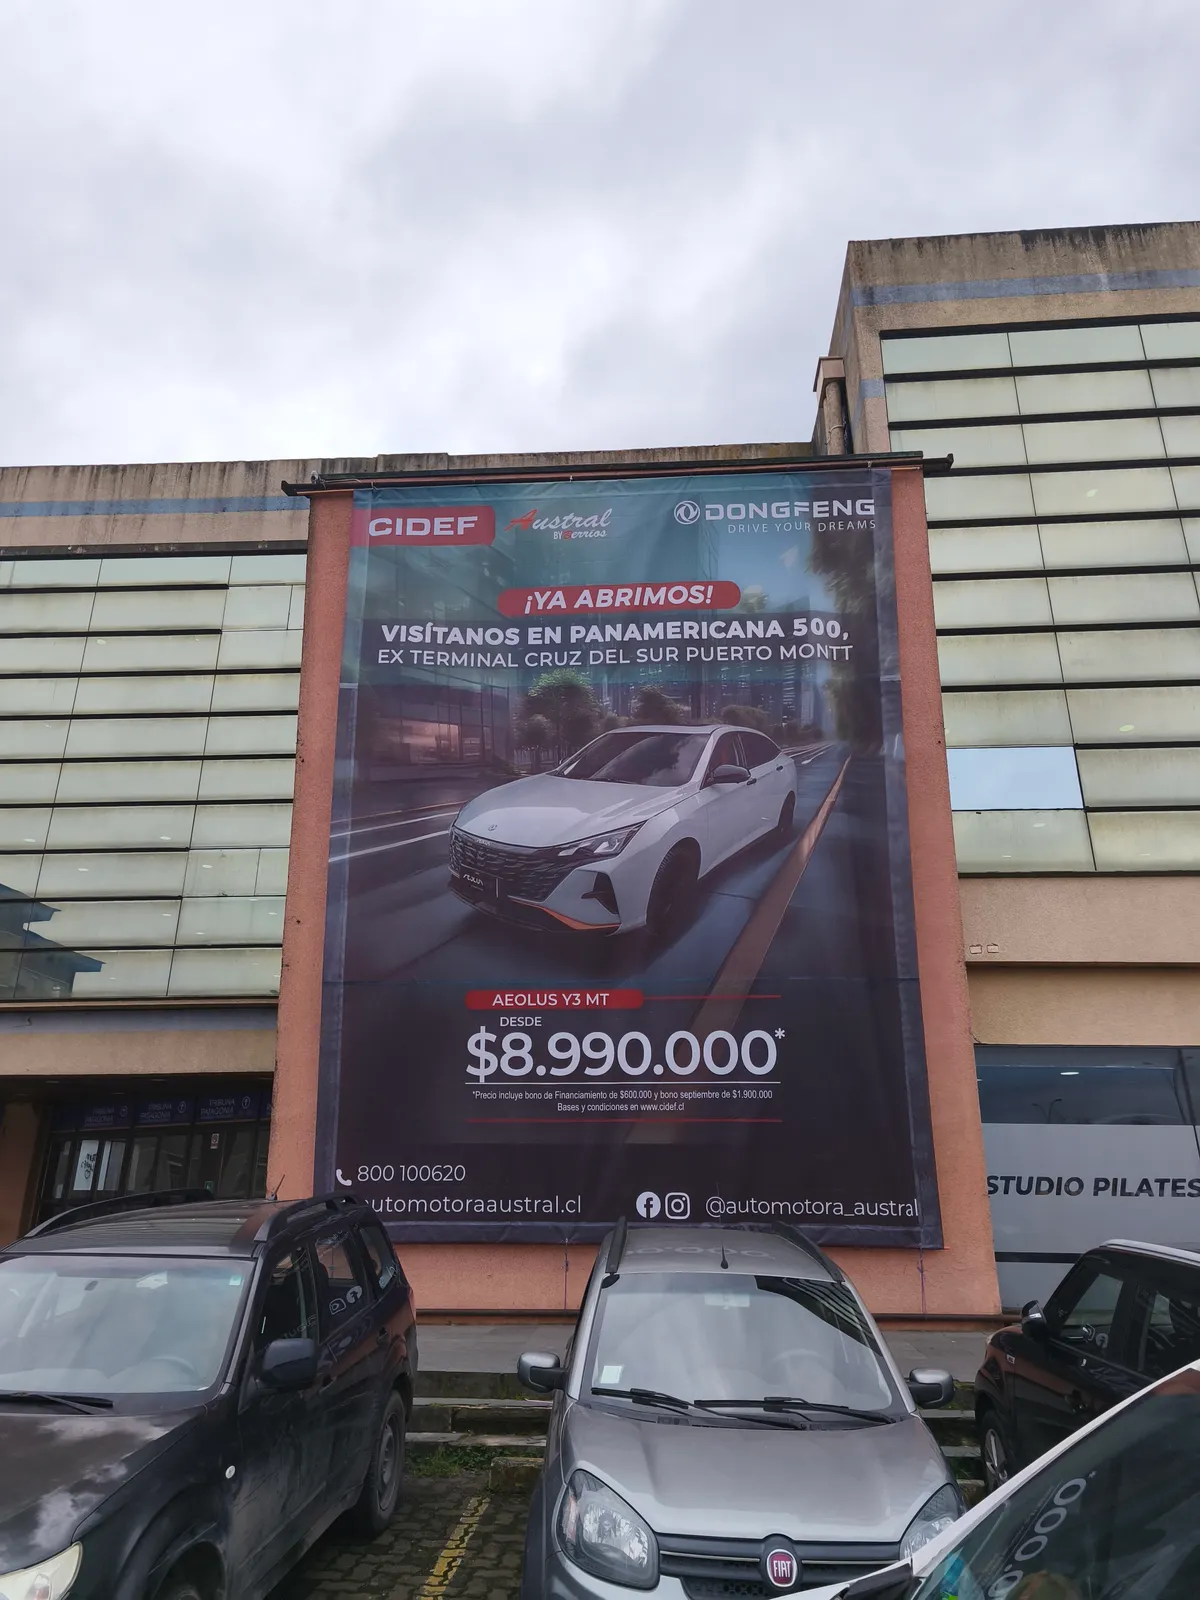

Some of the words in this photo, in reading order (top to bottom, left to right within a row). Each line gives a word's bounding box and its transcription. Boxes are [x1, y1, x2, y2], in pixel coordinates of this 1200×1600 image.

[705, 498, 875, 521] DONGFENG
[368, 515, 479, 537] CIDEF
[504, 508, 613, 532] Austral
[727, 523, 768, 534] DRIVE
[774, 521, 811, 533] YOUR
[817, 519, 876, 533] DREAMS
[553, 531, 563, 540] BY
[524, 589, 567, 615] ¡YA
[573, 584, 714, 609] ABRIMOS!
[381, 622, 520, 646] VISÍTANOS
[527, 626, 562, 645] EN
[570, 619, 785, 644] PANAMERICANA
[792, 617, 850, 641] 500,
[377, 649, 404, 665] EX
[409, 649, 519, 668] TERMINAL
[524, 651, 582, 667] CRUZ
[589, 649, 631, 665] DEL
[636, 647, 679, 663] SUR
[686, 645, 772, 662] PUERTO
[780, 642, 854, 661] MONTT
[492, 992, 557, 1007] AEOLUS
[562, 993, 581, 1006] Y3
[586, 992, 609, 1006] MT
[500, 1016, 542, 1027] DESDE
[498, 1090, 523, 1101] incluye
[524, 1090, 541, 1099] bono
[543, 1090, 553, 1099] de
[554, 1090, 607, 1099] Financiamiento
[608, 1090, 618, 1099] de
[619, 1089, 652, 1099] $600.000
[660, 1089, 679, 1099] bono
[680, 1089, 719, 1100] septiembre
[721, 1089, 731, 1099] de
[732, 1088, 773, 1099] $1.900.000
[557, 1102, 580, 1111] Bases
[587, 1102, 628, 1111] condiciones
[629, 1103, 639, 1111] en
[640, 1101, 685, 1111] www.cidef.cl
[357, 1164, 395, 1182] 800
[399, 1164, 466, 1182] 100620
[987, 1175, 1085, 1197] STUDIO
[1093, 1177, 1200, 1198] PILATES
[365, 1195, 582, 1214] utomotoraaustral.cl
[705, 1196, 919, 1218] @automotora_austral
[773, 1560, 791, 1578] FIAT
